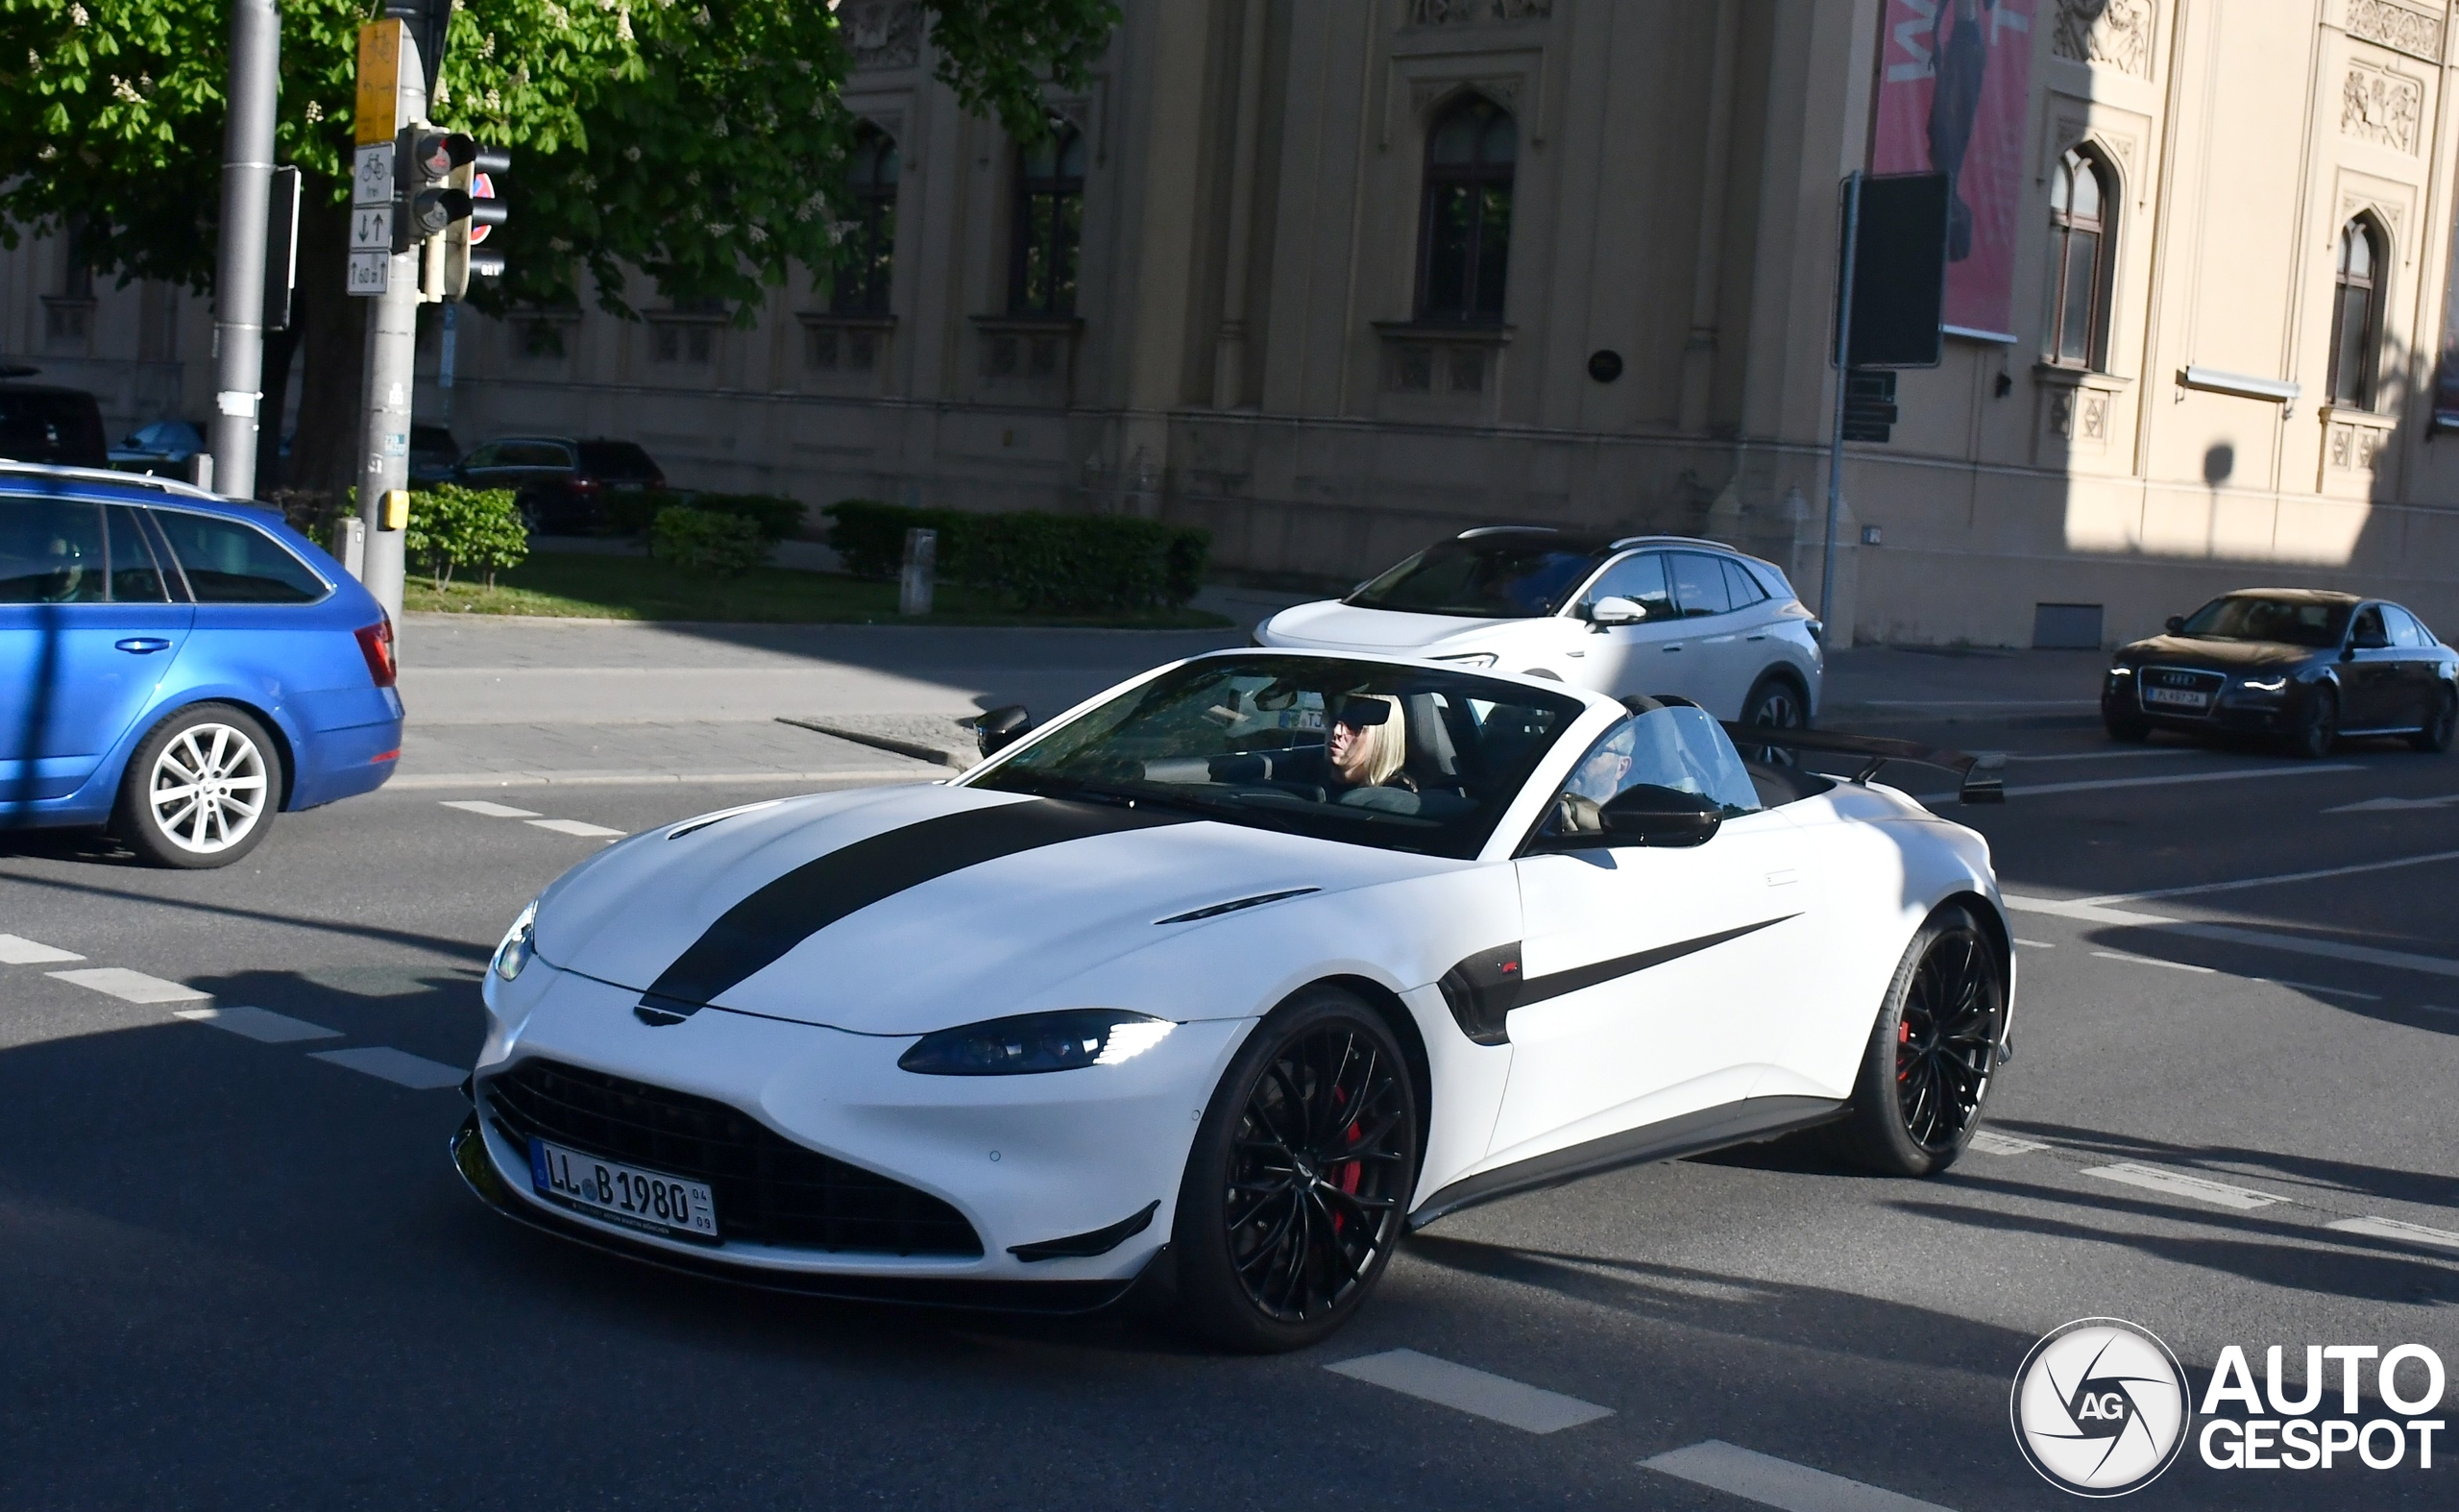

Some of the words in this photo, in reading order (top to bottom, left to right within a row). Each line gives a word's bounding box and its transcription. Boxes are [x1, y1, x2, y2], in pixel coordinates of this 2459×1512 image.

[359, 267, 370, 283] 60
[547, 1149, 580, 1195] LL
[693, 1187, 707, 1201] 04
[696, 1217, 711, 1229] 09
